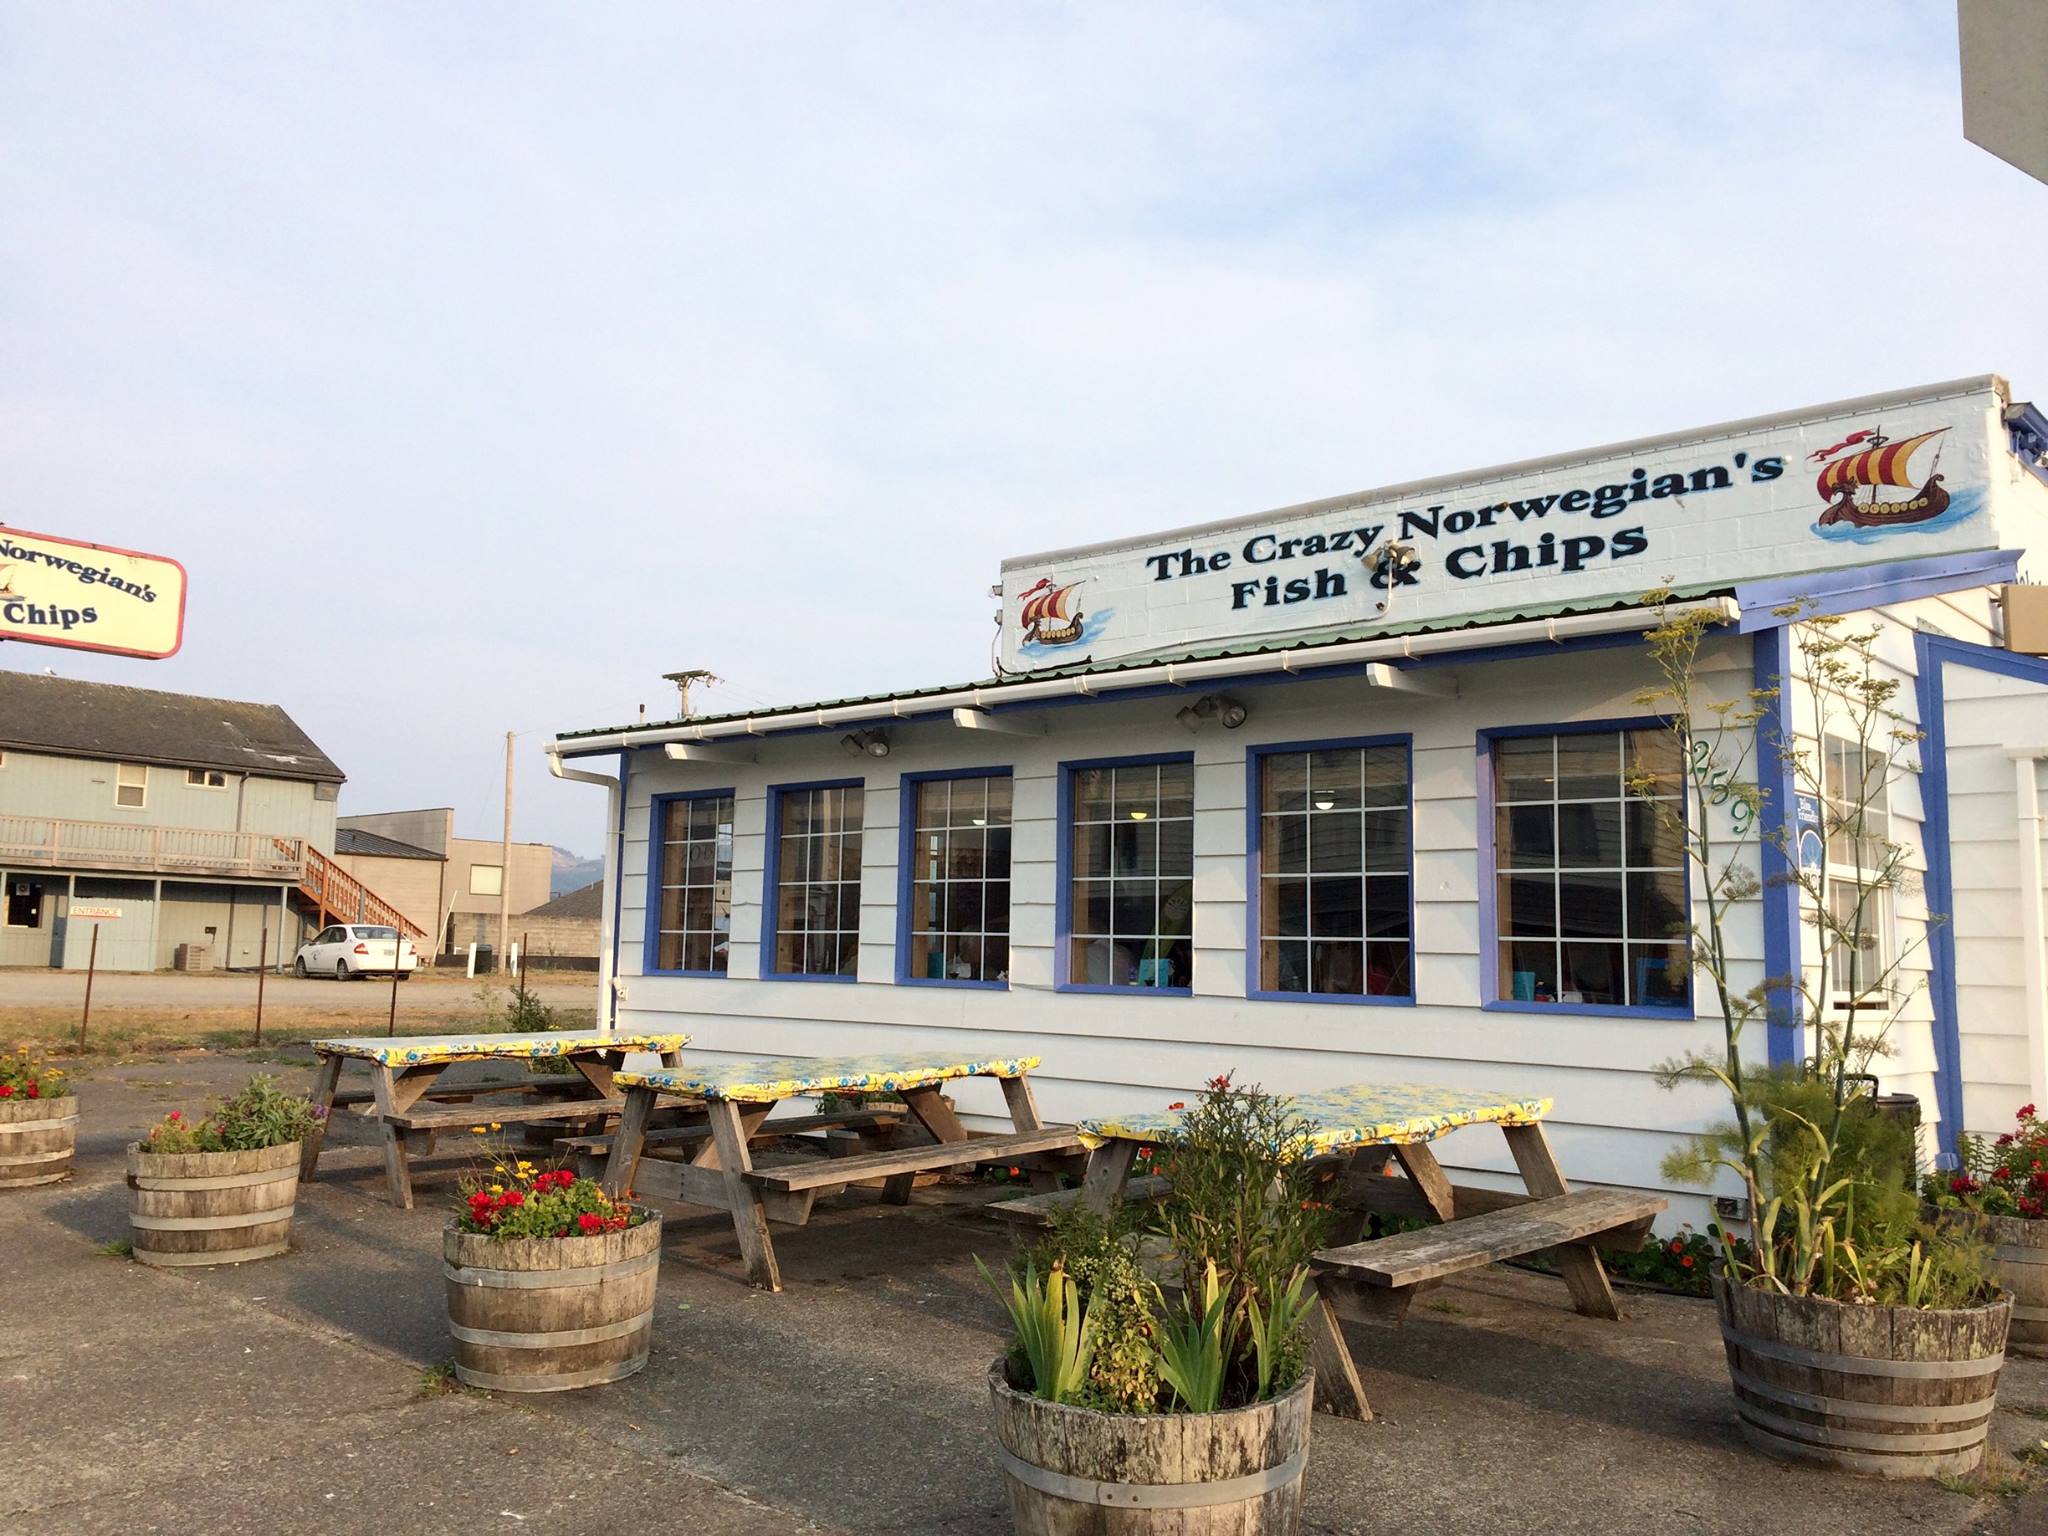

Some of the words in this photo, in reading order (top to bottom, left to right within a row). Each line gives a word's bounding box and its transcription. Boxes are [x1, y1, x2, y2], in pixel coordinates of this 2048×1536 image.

[1146, 548, 1231, 581] The
[1243, 525, 1384, 563] Crazy
[1397, 452, 1784, 540] Norwegian's
[1231, 568, 1347, 609] Fish
[1371, 557, 1421, 589] &
[1445, 526, 1649, 579] Chips
[3, 602, 98, 629] Chips
[73, 907, 119, 915] ENTRANCE
